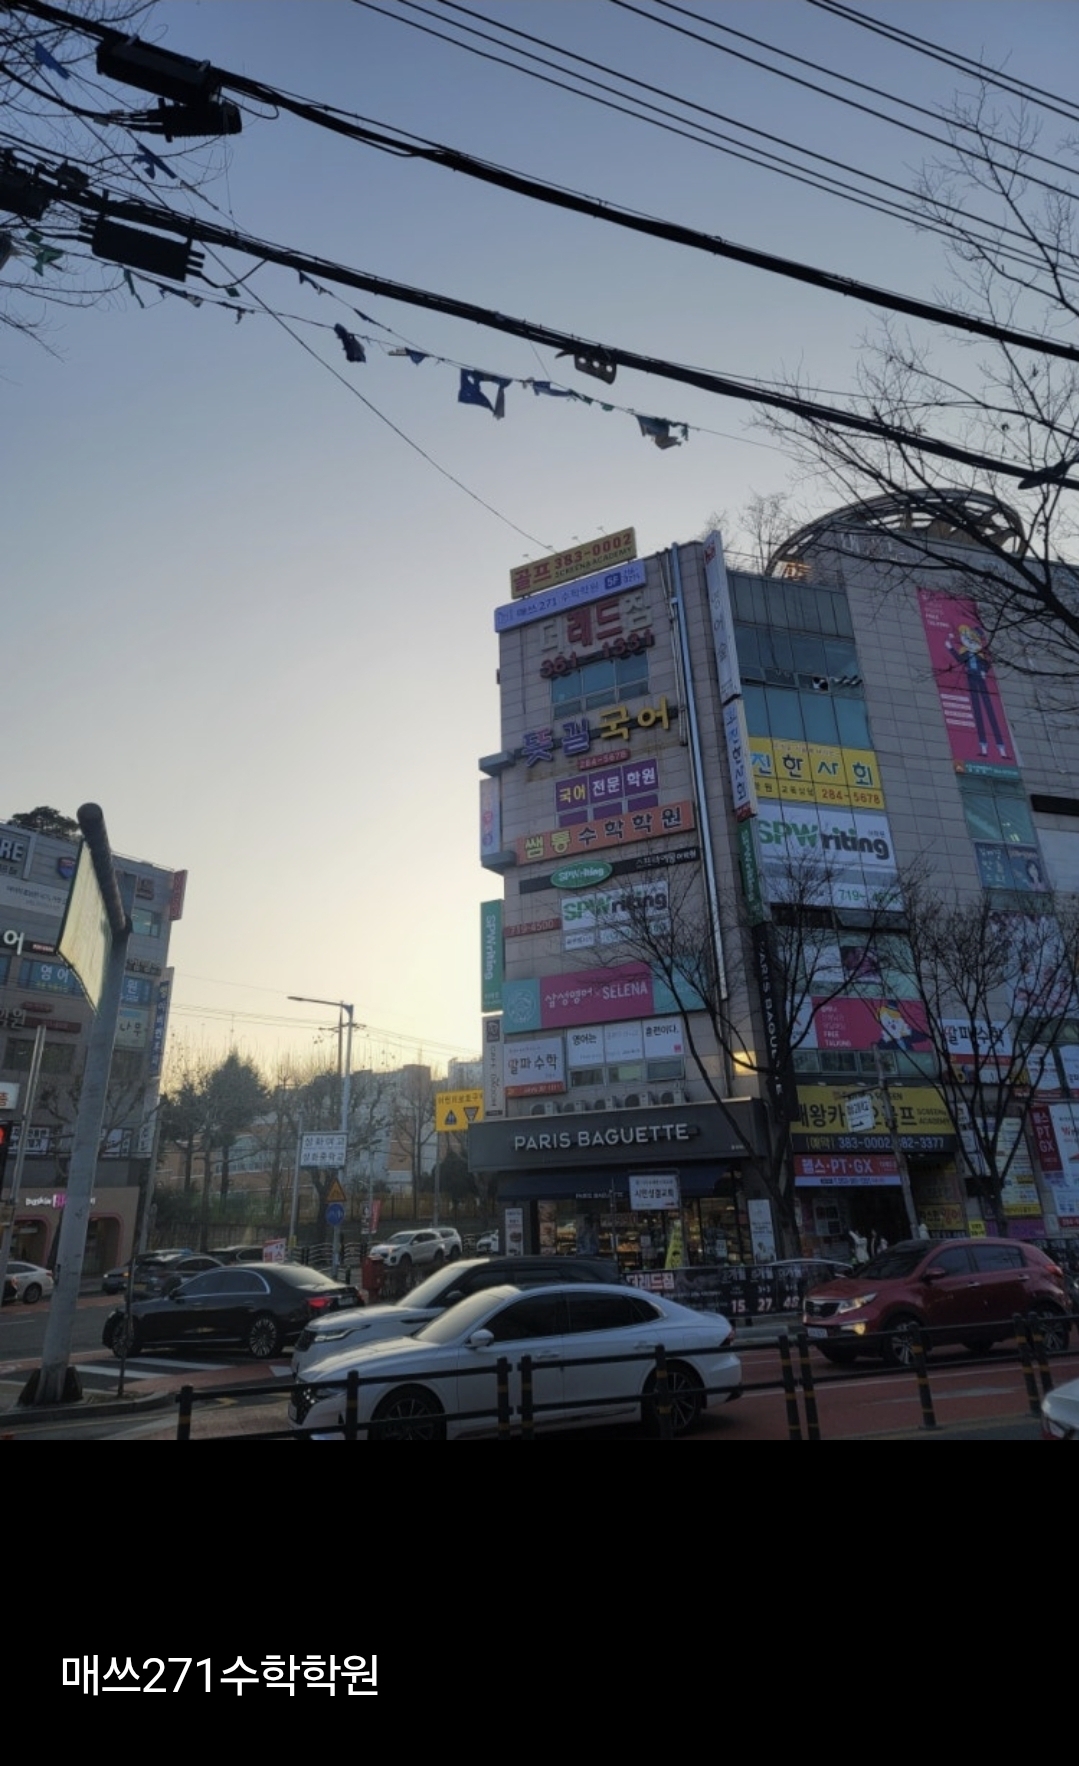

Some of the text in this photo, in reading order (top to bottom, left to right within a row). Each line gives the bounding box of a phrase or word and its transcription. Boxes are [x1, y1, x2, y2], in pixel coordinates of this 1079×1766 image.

[514, 532, 632, 592] 골프 383-0002
[516, 598, 558, 617] 매쓰271
[606, 575, 620, 589] 5F
[541, 591, 653, 653] 더레드짐
[559, 767, 657, 803] 국어 전문 학원
[821, 788, 881, 805] 284-5678
[759, 819, 890, 861] SPWriting
[3, 929, 25, 956] 어
[41, 964, 70, 983] 영어
[545, 981, 648, 1009] 삼성영어 SELENA
[572, 1032, 597, 1046] 영어는
[645, 1024, 679, 1037] 훈련이다.
[508, 1053, 557, 1075] 알파수학
[514, 1122, 690, 1151] PARIS BAGUETTE
[1036, 1125, 1050, 1139] PT
[1039, 1141, 1055, 1153] GX
[730, 1298, 747, 1314] 15
[756, 1296, 773, 1313] 27
